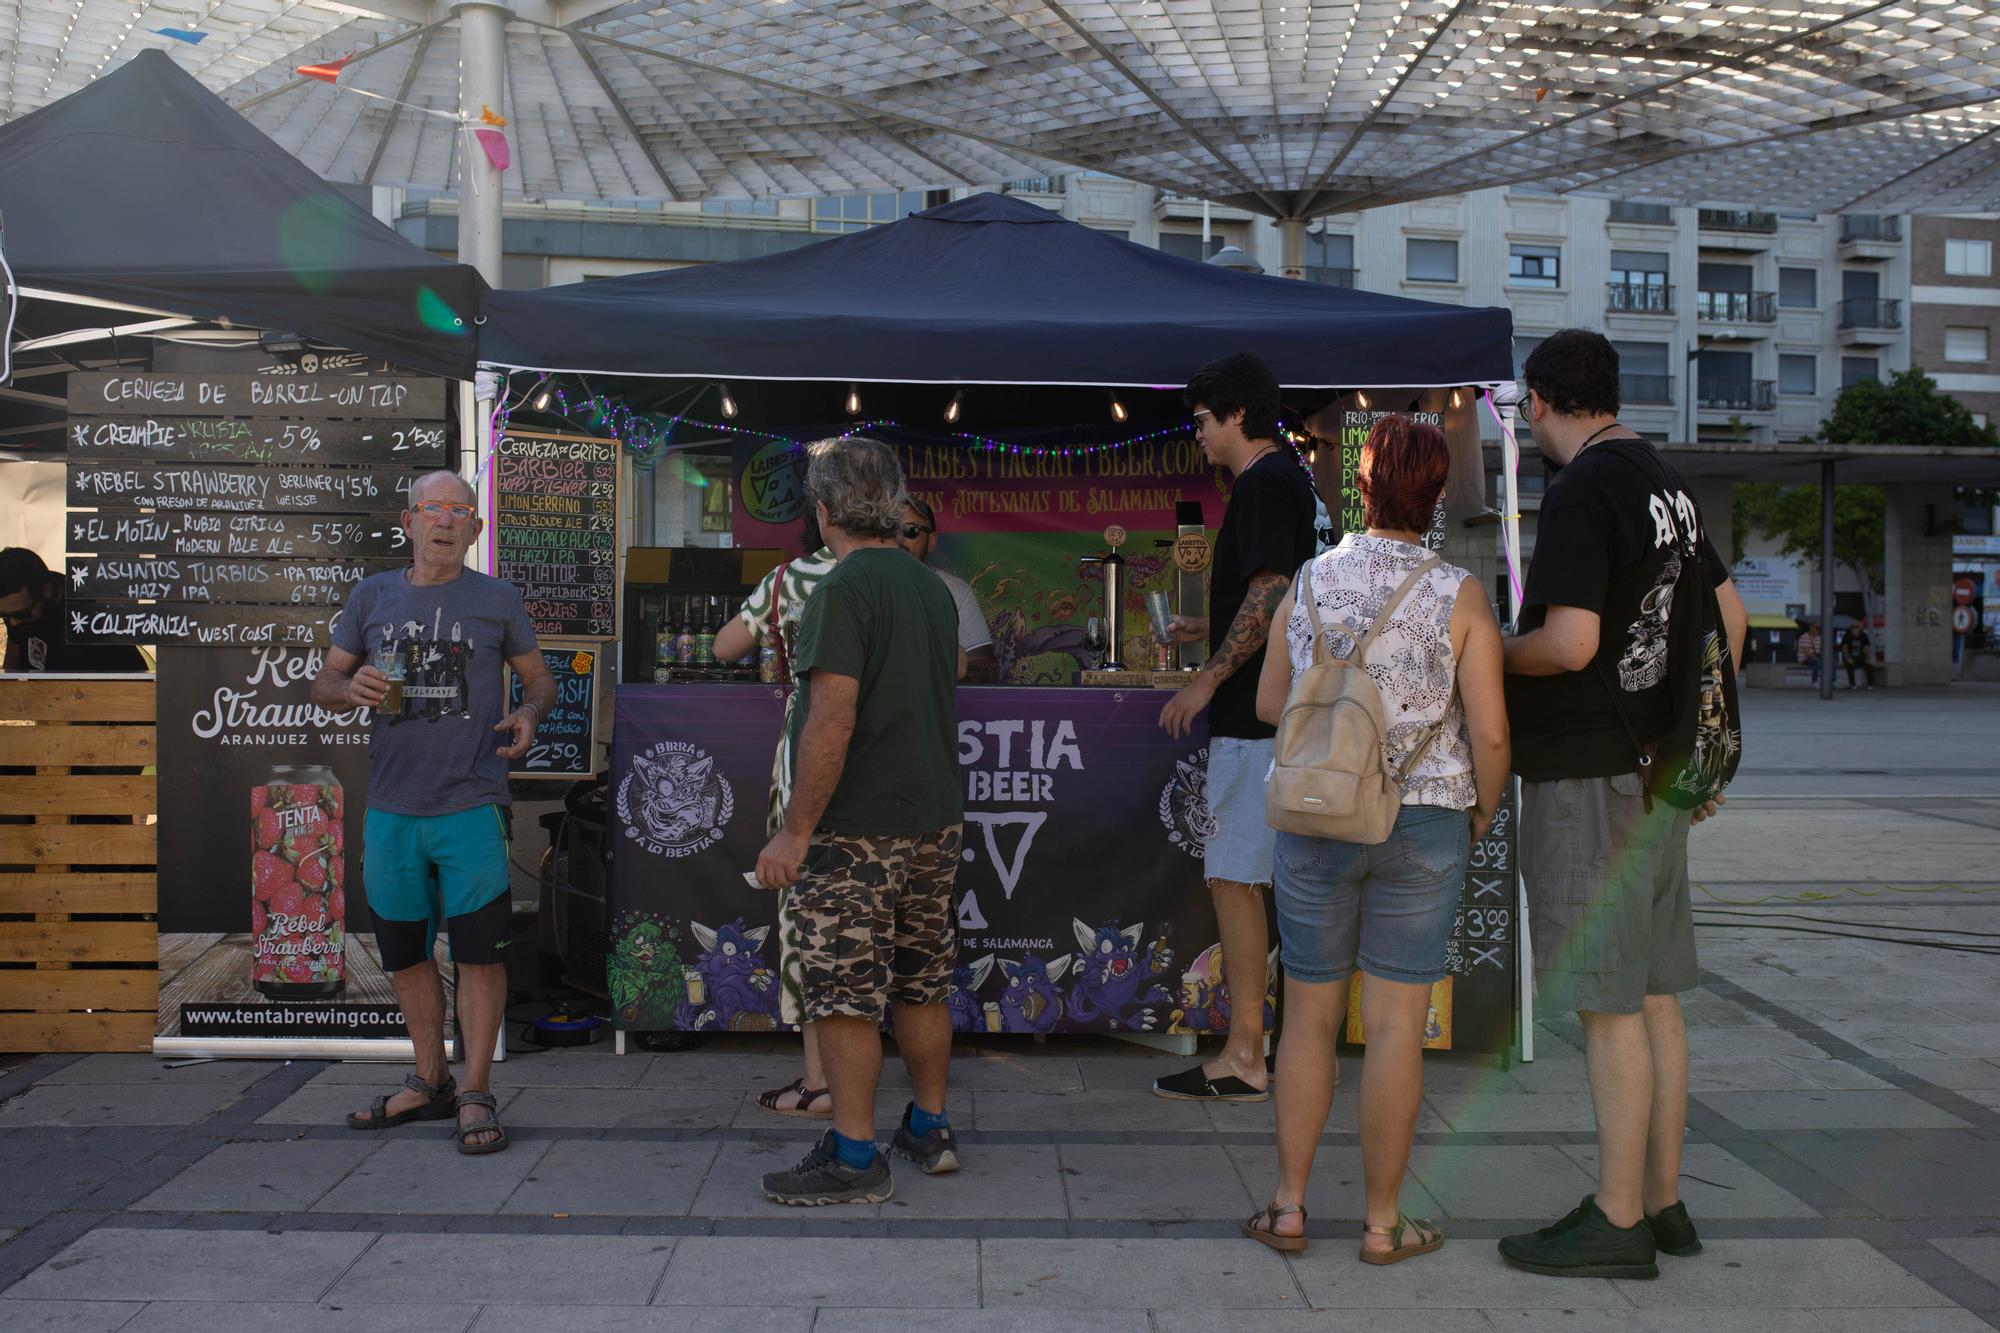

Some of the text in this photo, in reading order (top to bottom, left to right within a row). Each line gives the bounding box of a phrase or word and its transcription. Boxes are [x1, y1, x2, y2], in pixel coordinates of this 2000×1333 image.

[103, 378, 185, 402] CERVEZA
[199, 382, 226, 404] DE
[251, 381, 324, 404] BARRIL
[369, 384, 407, 408] TAP
[278, 425, 321, 454] 5%
[1342, 424, 1369, 447] LIMÓ
[498, 437, 560, 459] CERVEZA
[93, 471, 145, 495] REBEL
[153, 470, 270, 499] STRAWBERRY
[278, 473, 332, 492] BERLINER
[334, 474, 378, 500] 4'5%
[133, 494, 318, 512] CON FRESON DE ARANJUEZ WEISSE
[530, 495, 581, 514] SERRANO
[952, 488, 1050, 519] ARTESANAS
[1058, 489, 1081, 512] DE
[1086, 486, 1183, 515] SALAMANCA
[87, 518, 110, 543] EL
[184, 513, 222, 533] RUBIA
[309, 522, 364, 546] 5'5%
[564, 516, 583, 529] ALE
[228, 532, 260, 554] PALE
[266, 537, 294, 555] ALE
[499, 528, 540, 548] MANGO
[519, 549, 540, 564] HAZY
[95, 560, 181, 582] ASUNTOS
[187, 561, 270, 584] TURBIOS
[127, 582, 341, 604] HAZY IPA 6'7%
[197, 623, 238, 643] WEST
[282, 625, 315, 643] IPA
[246, 646, 325, 688] Reb
[191, 686, 373, 739] Strawber
[220, 733, 371, 745] ARANJUEZ WEISS
[654, 740, 696, 755] BIRRA
[957, 719, 1085, 770] STIA
[967, 770, 1056, 802] BEER
[275, 805, 322, 829] TENTA
[634, 835, 715, 858] A LO BESTIA
[270, 913, 326, 937] Rebel
[253, 933, 344, 965] Strawberry
[963, 937, 1054, 949] DE SALAMANCA
[186, 1008, 406, 1027] www.tentabrewingco.co
